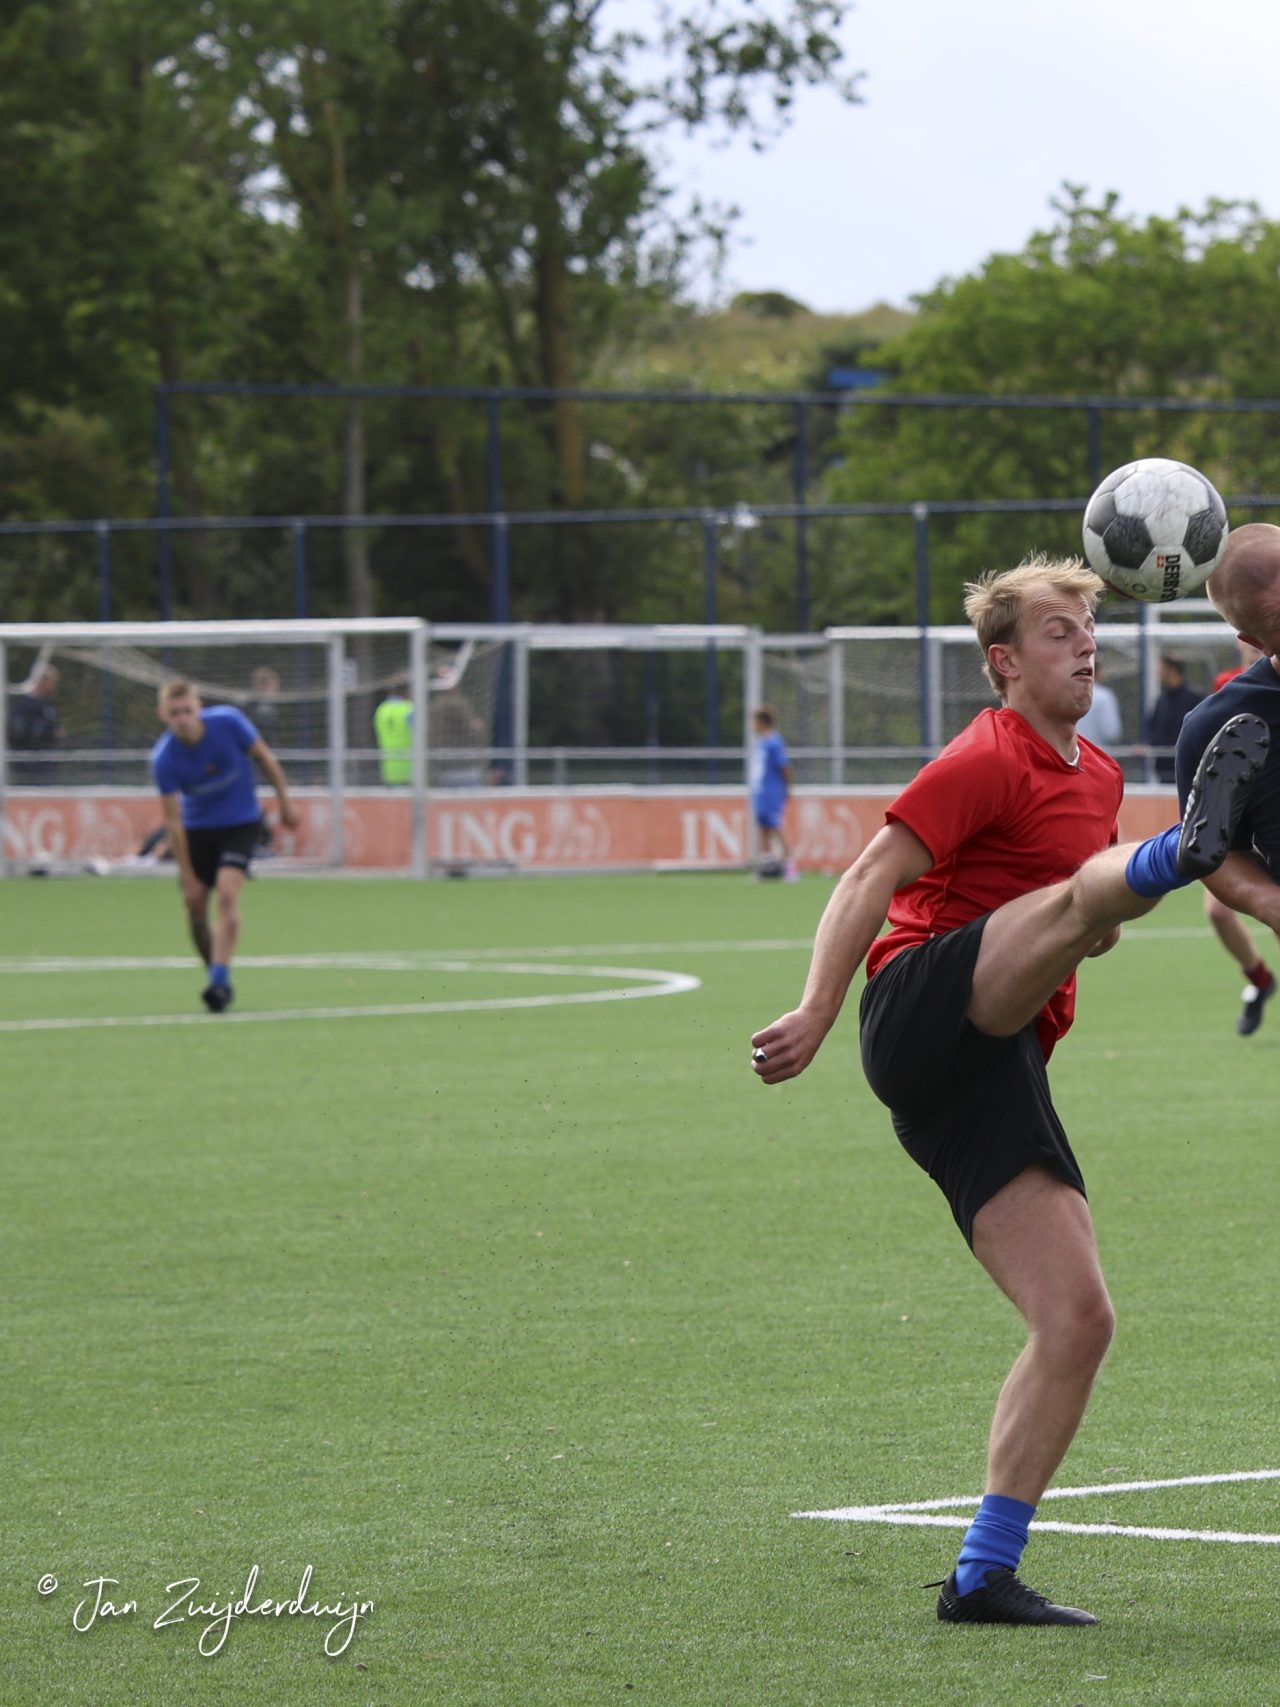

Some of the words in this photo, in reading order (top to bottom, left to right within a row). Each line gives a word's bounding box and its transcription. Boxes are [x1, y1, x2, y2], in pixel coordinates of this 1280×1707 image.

[2, 808, 66, 859] NG
[438, 810, 538, 861] ING
[682, 810, 746, 862] IN
